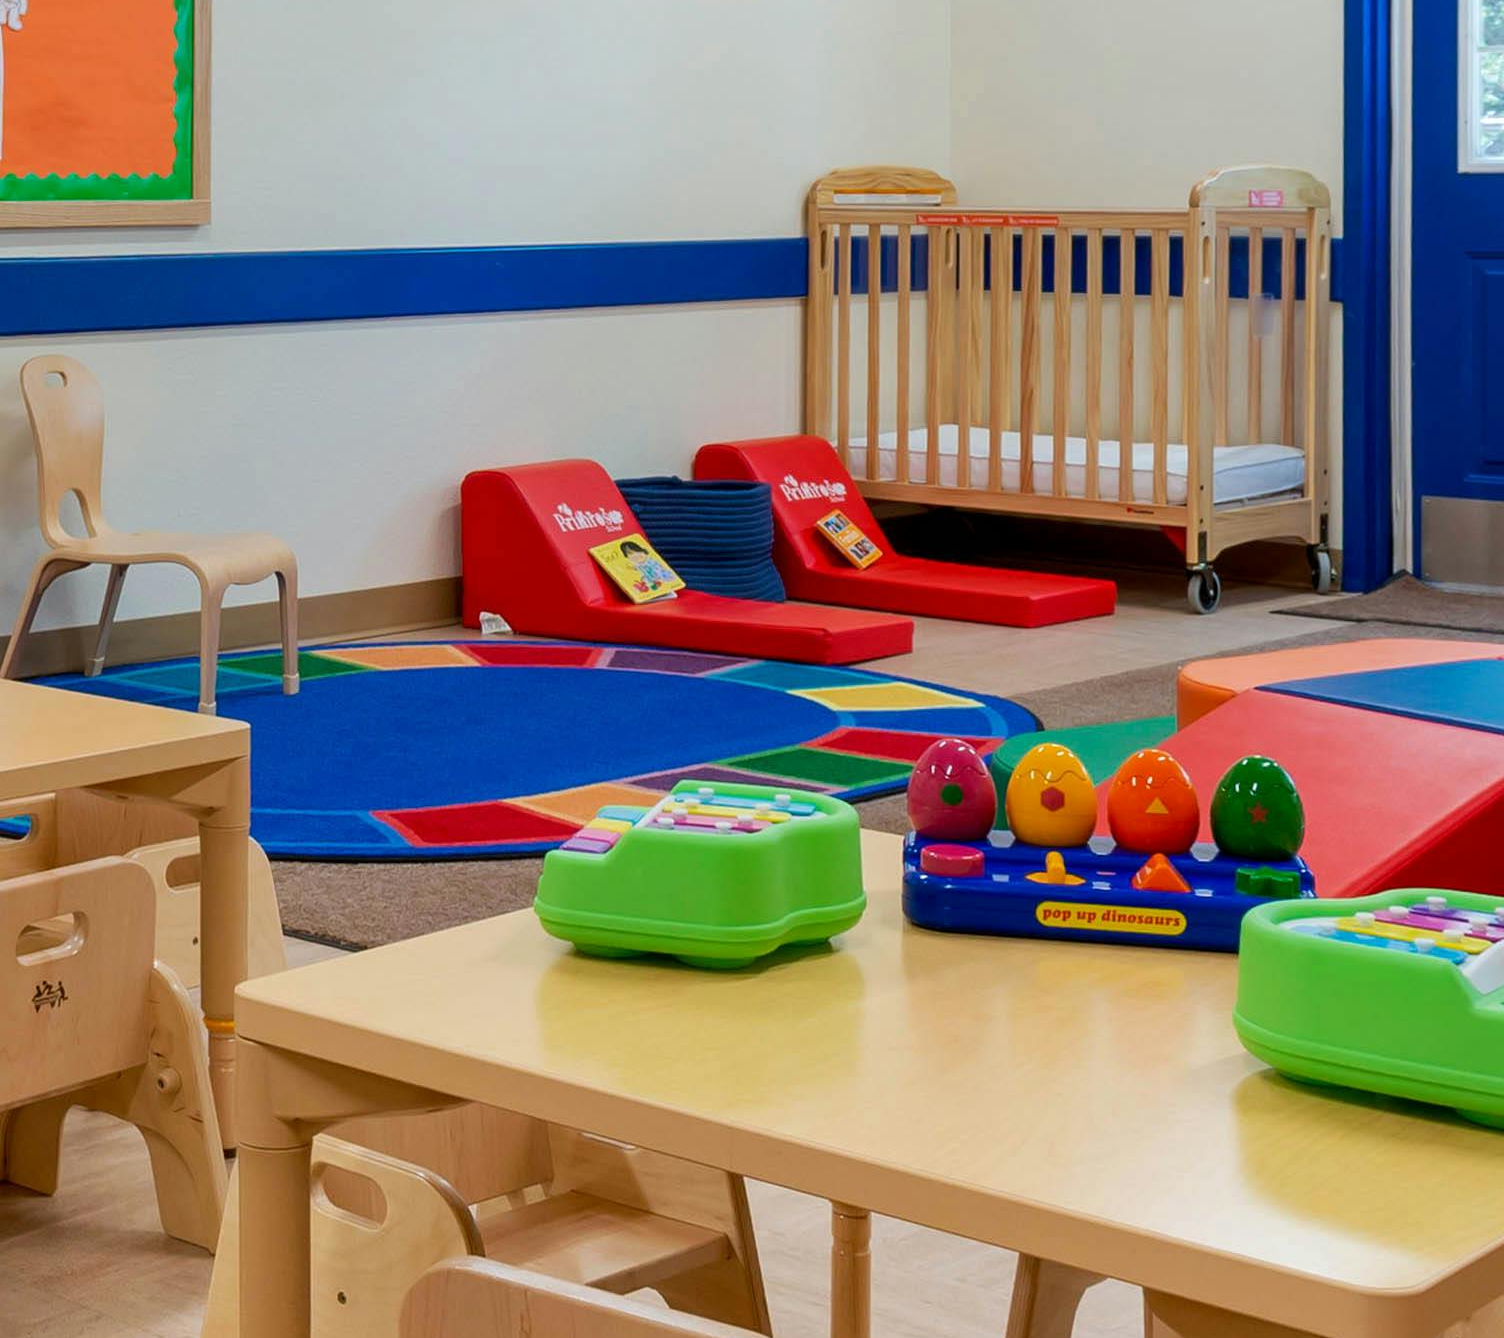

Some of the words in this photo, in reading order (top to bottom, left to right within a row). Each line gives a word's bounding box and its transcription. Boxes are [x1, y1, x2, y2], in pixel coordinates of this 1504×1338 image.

[1043, 907, 1072, 921] pop
[1076, 911, 1097, 924] up
[1101, 909, 1181, 927] dinosaurs
